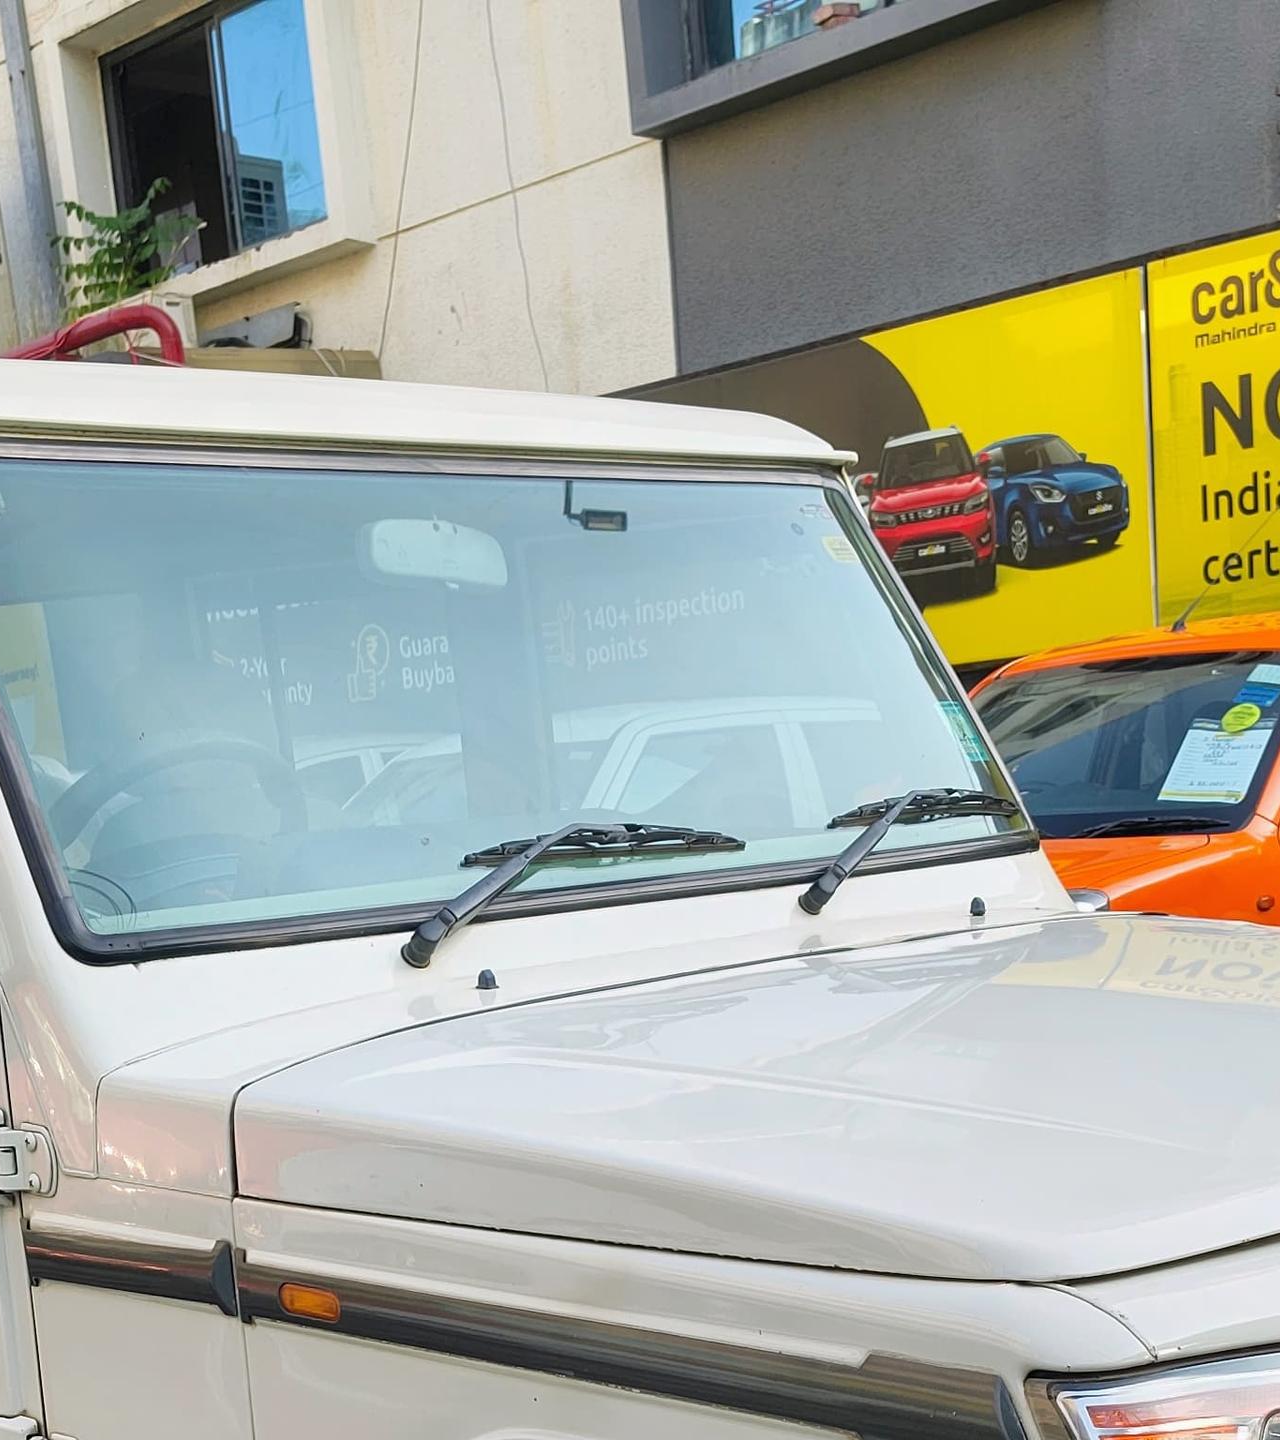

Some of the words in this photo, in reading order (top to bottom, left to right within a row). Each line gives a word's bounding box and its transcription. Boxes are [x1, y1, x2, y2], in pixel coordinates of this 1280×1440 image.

[1194, 322, 1276, 349] Mahindra
[583, 602, 630, 631] 140+
[635, 586, 746, 626] inspection
[586, 634, 649, 672] points
